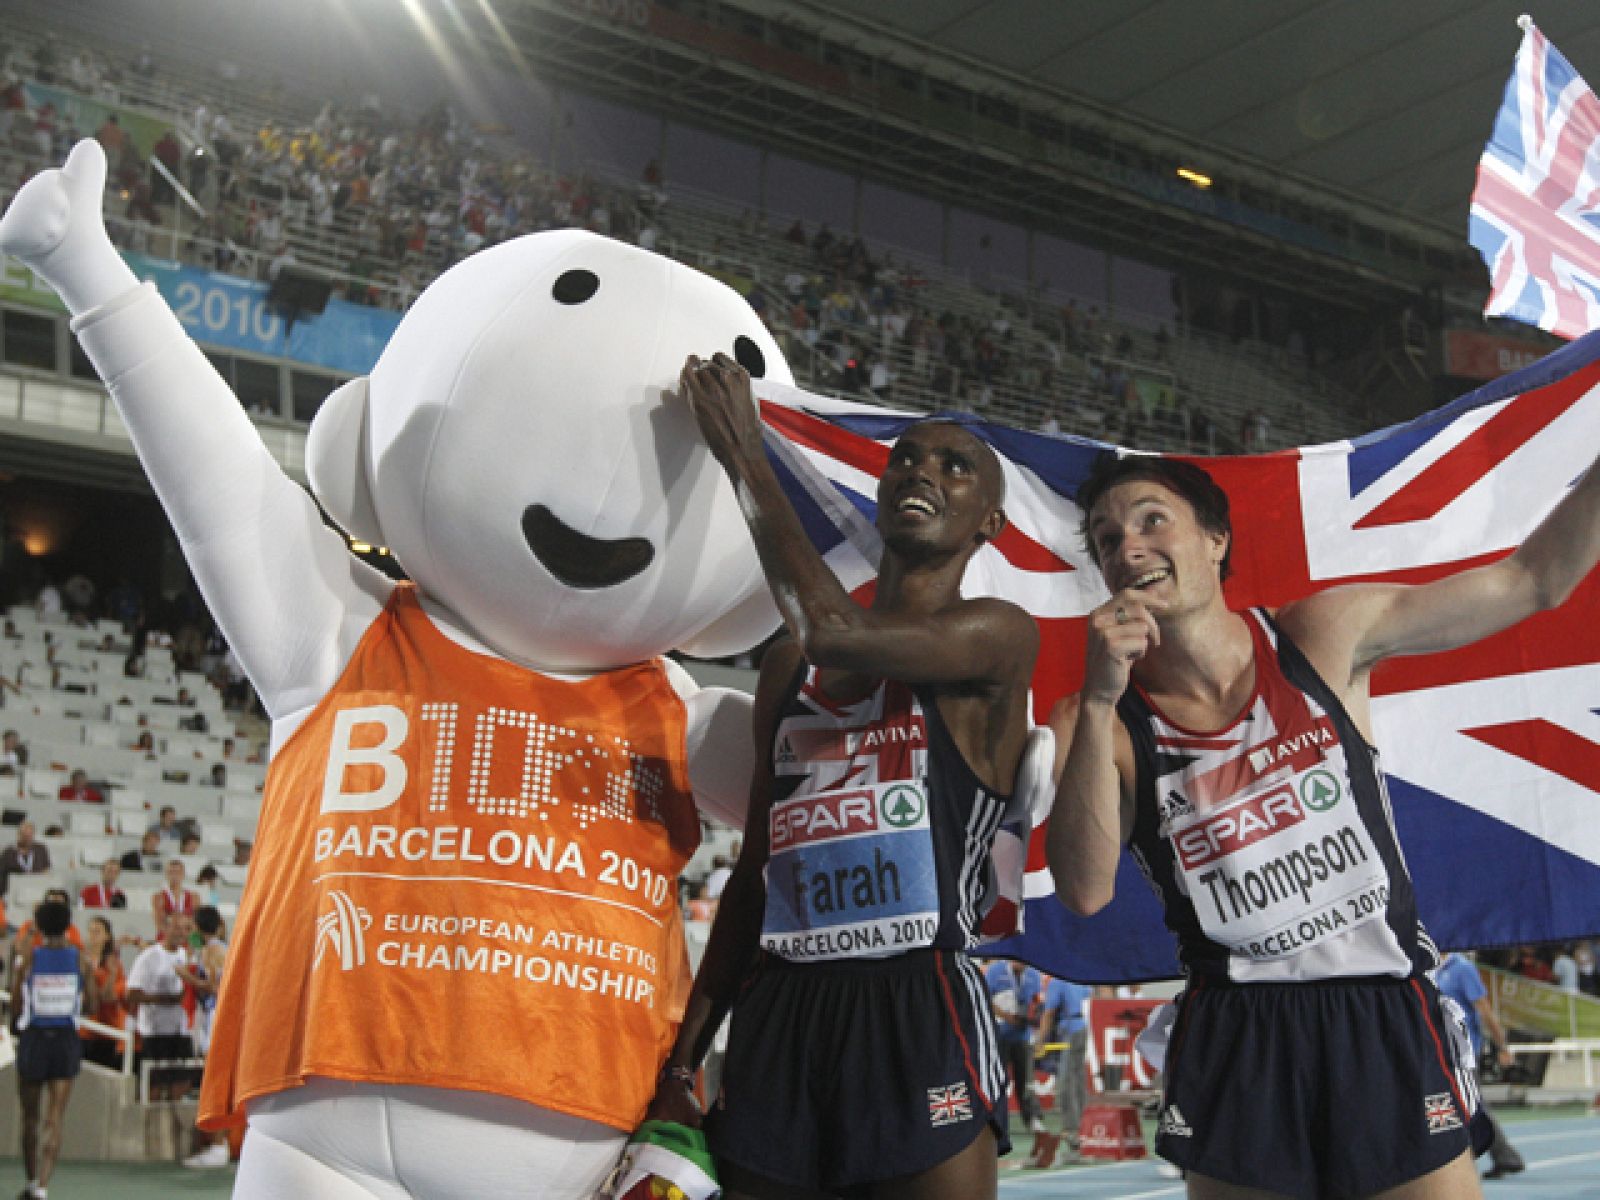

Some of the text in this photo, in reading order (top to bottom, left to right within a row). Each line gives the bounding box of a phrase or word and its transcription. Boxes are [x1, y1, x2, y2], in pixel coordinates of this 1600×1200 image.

[174, 283, 280, 342] 2010
[865, 725, 921, 746] AVIVA
[1277, 727, 1333, 760] AVIVA
[773, 797, 874, 843] SPAR
[1180, 792, 1300, 864] SPAR
[314, 825, 669, 907] BARCELONA 2010
[792, 847, 901, 918] Farah
[1198, 826, 1368, 924] Thompson
[384, 914, 534, 944] EUROPEAN
[890, 917, 936, 944] 2010
[1236, 907, 1347, 956] ARCELONA
